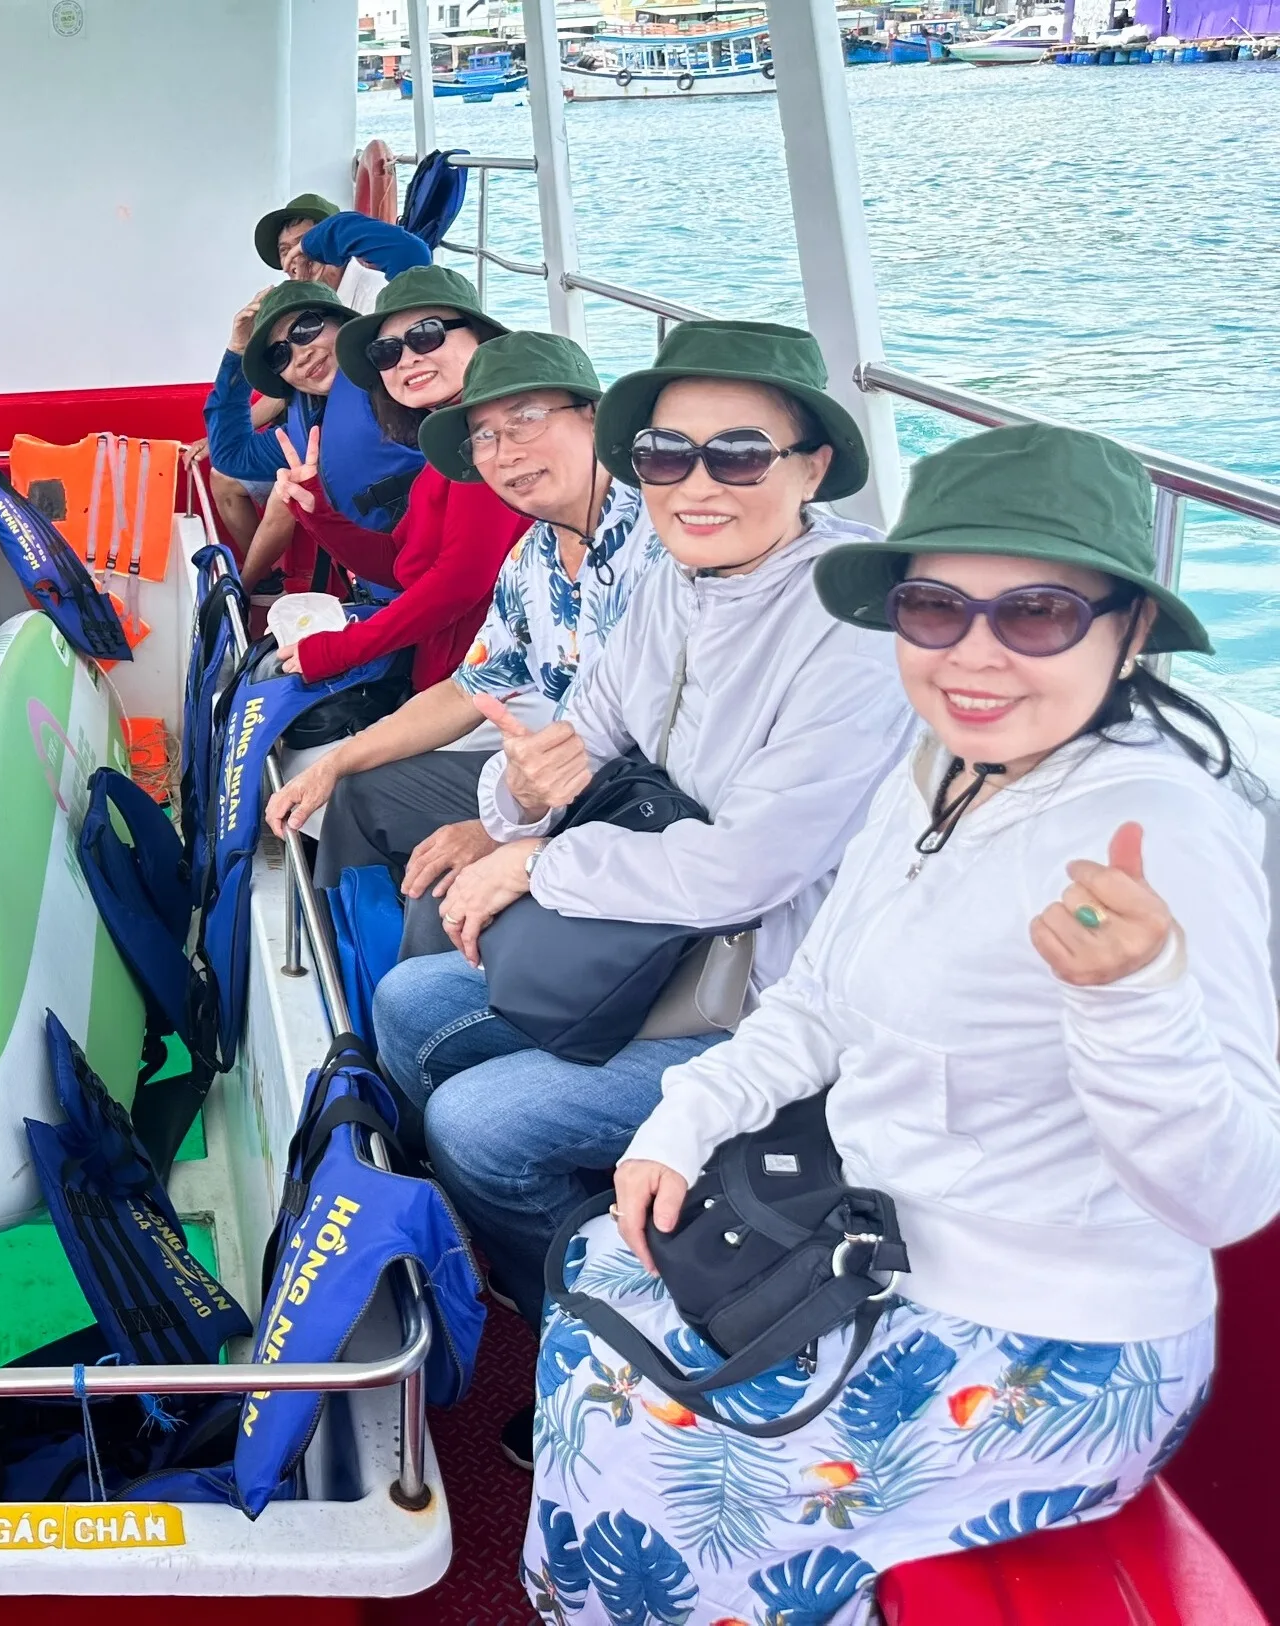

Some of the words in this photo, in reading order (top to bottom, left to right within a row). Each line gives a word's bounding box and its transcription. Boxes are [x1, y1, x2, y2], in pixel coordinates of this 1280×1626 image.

[236, 697, 266, 760] HỒNG
[287, 1195, 360, 1306] HỒNG
[174, 1277, 212, 1318] 4480
[73, 1511, 168, 1543] CHÂN
